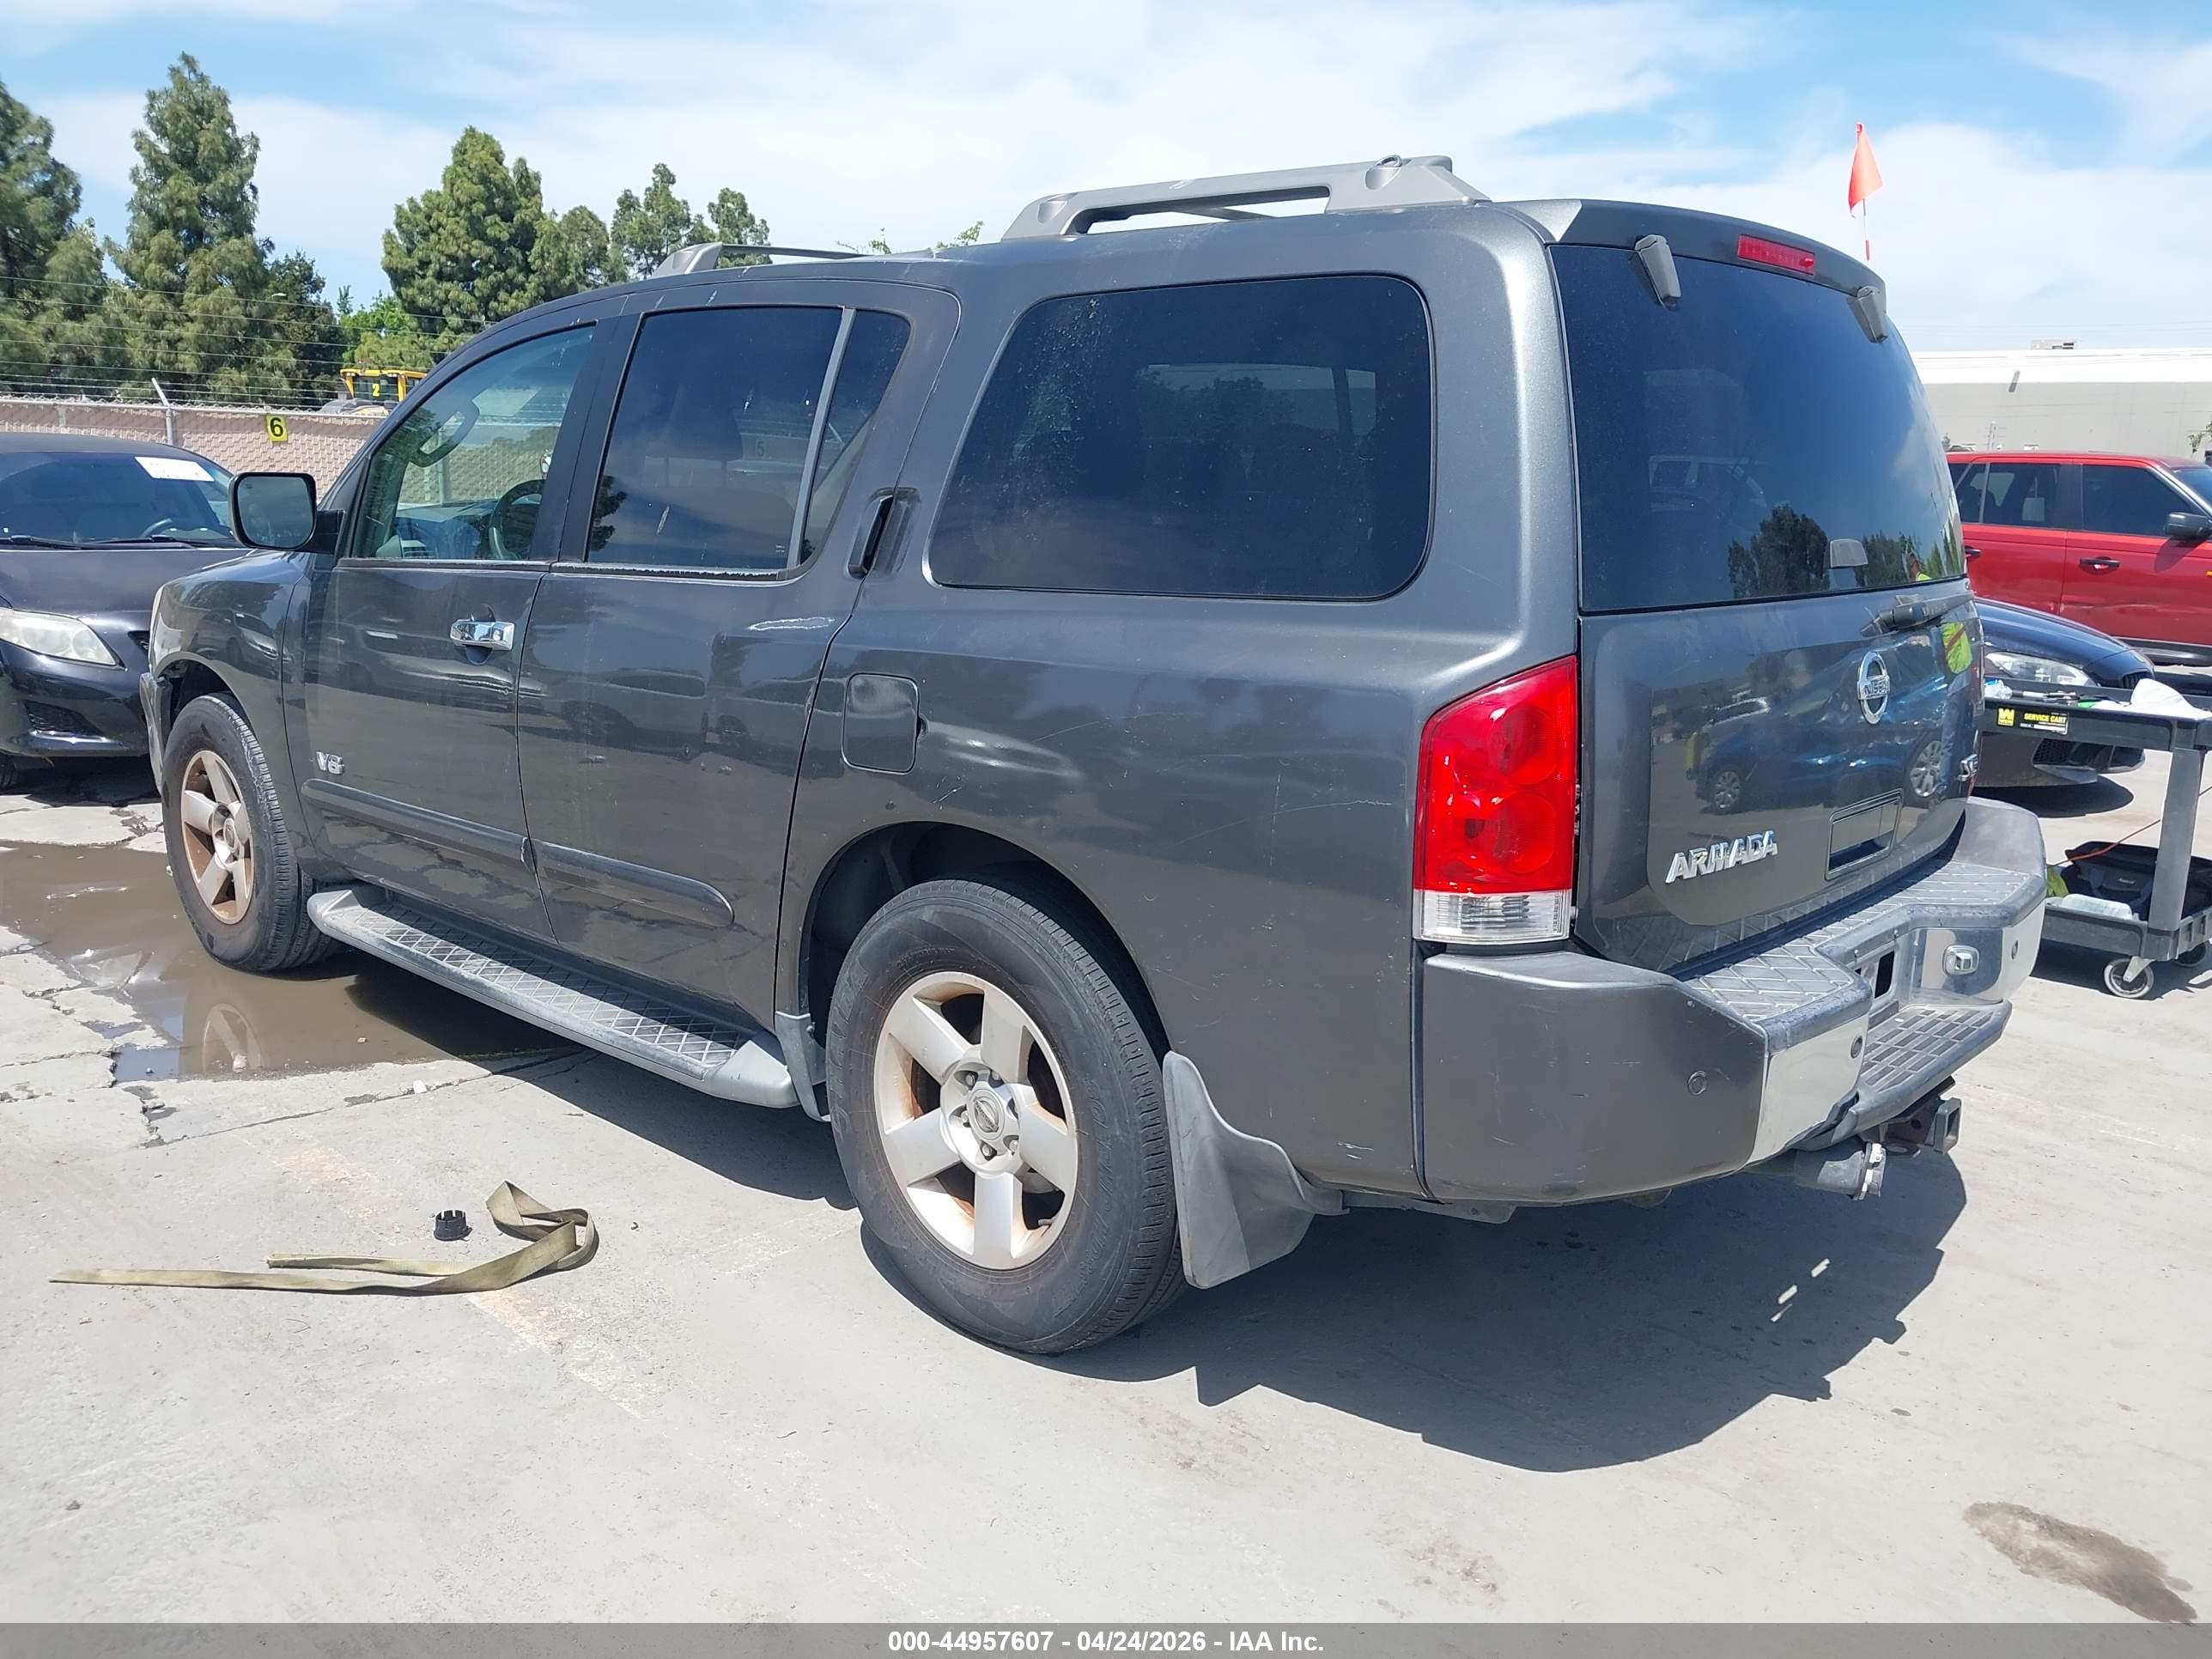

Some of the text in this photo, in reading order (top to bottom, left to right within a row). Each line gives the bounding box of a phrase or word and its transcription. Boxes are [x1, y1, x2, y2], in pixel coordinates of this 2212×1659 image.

[372, 383, 380, 397] 2
[270, 416, 284, 437] 6
[2024, 713, 2050, 722] SERVICE
[2050, 715, 2067, 724] CART
[1665, 830, 1779, 884] ARMADA
